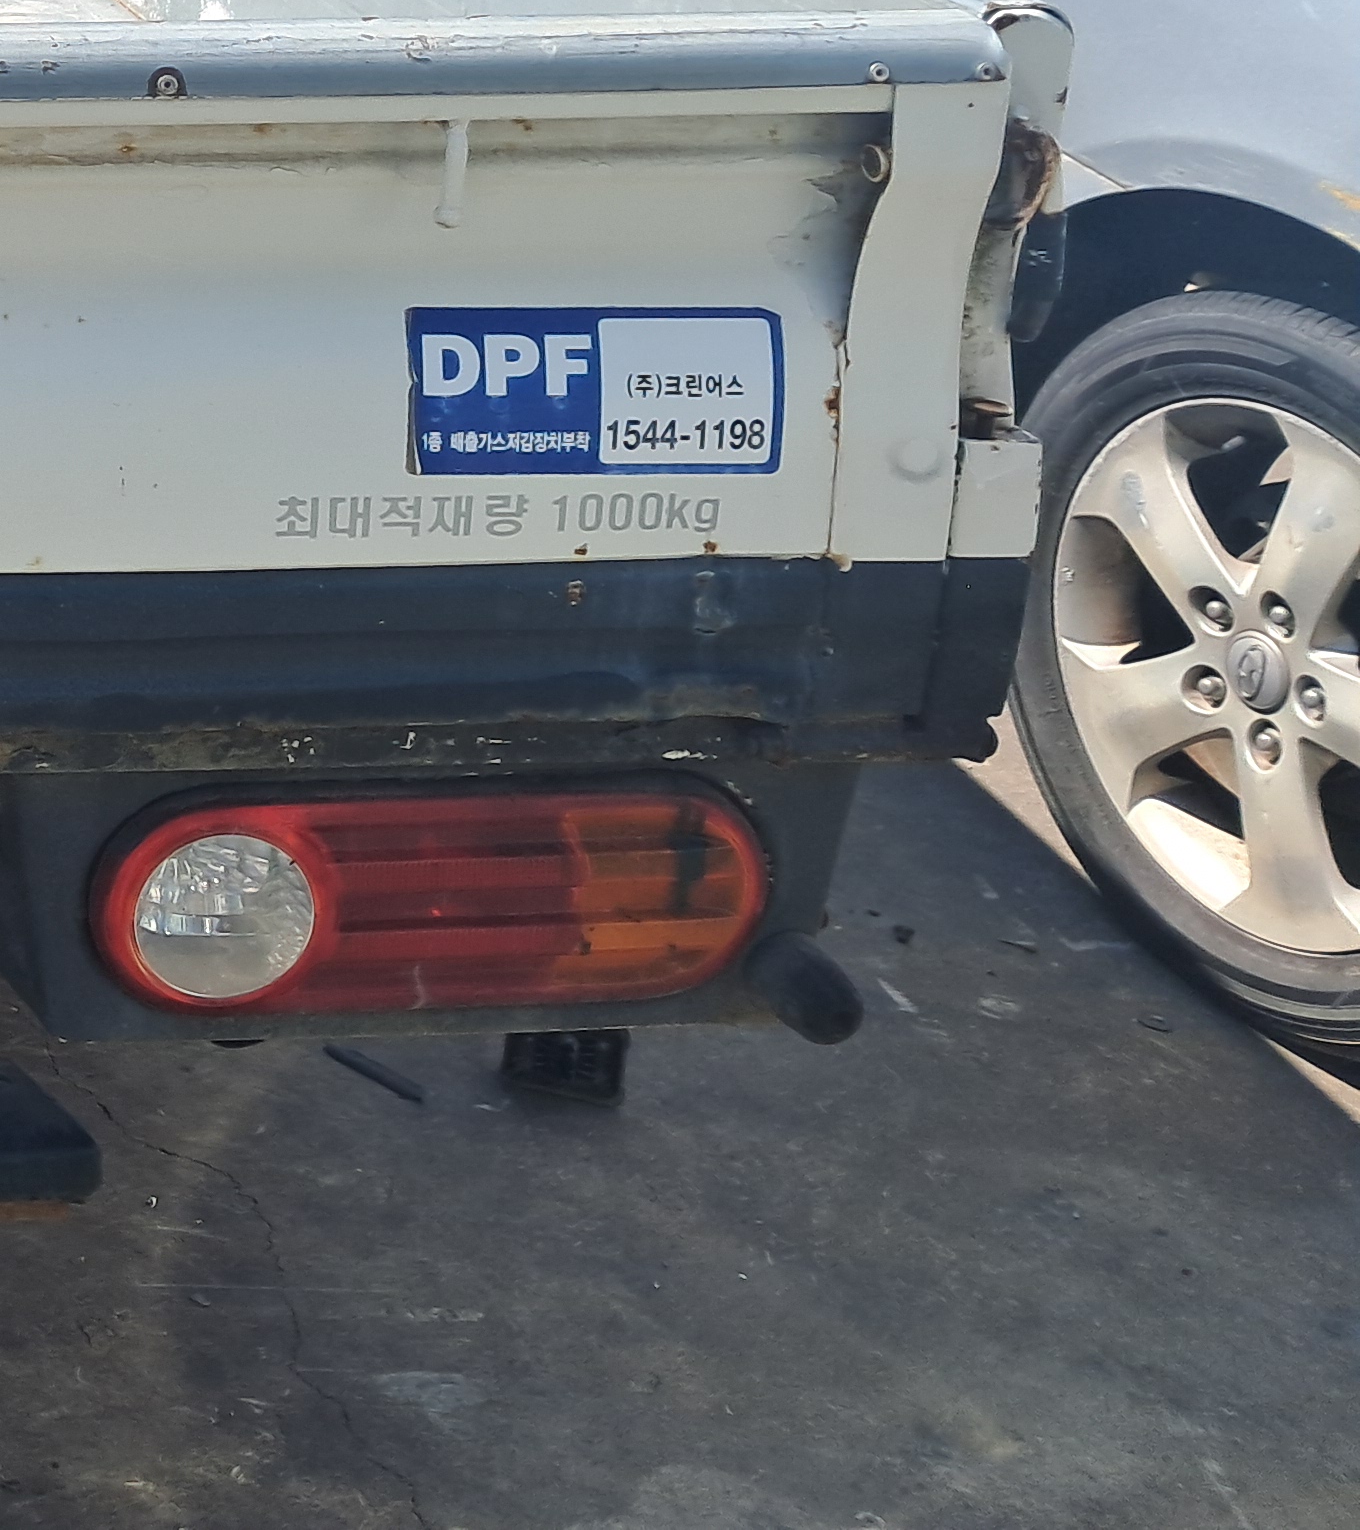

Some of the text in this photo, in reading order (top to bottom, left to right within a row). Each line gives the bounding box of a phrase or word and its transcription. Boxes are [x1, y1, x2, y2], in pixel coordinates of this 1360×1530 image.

[421, 333, 592, 397] DPF
[626, 372, 745, 399] (주)크린어스
[422, 430, 591, 453] 1종 배출가스저감장치부착
[606, 418, 766, 451] 1544-1198
[274, 491, 722, 538] 최대적재량 1000kg
